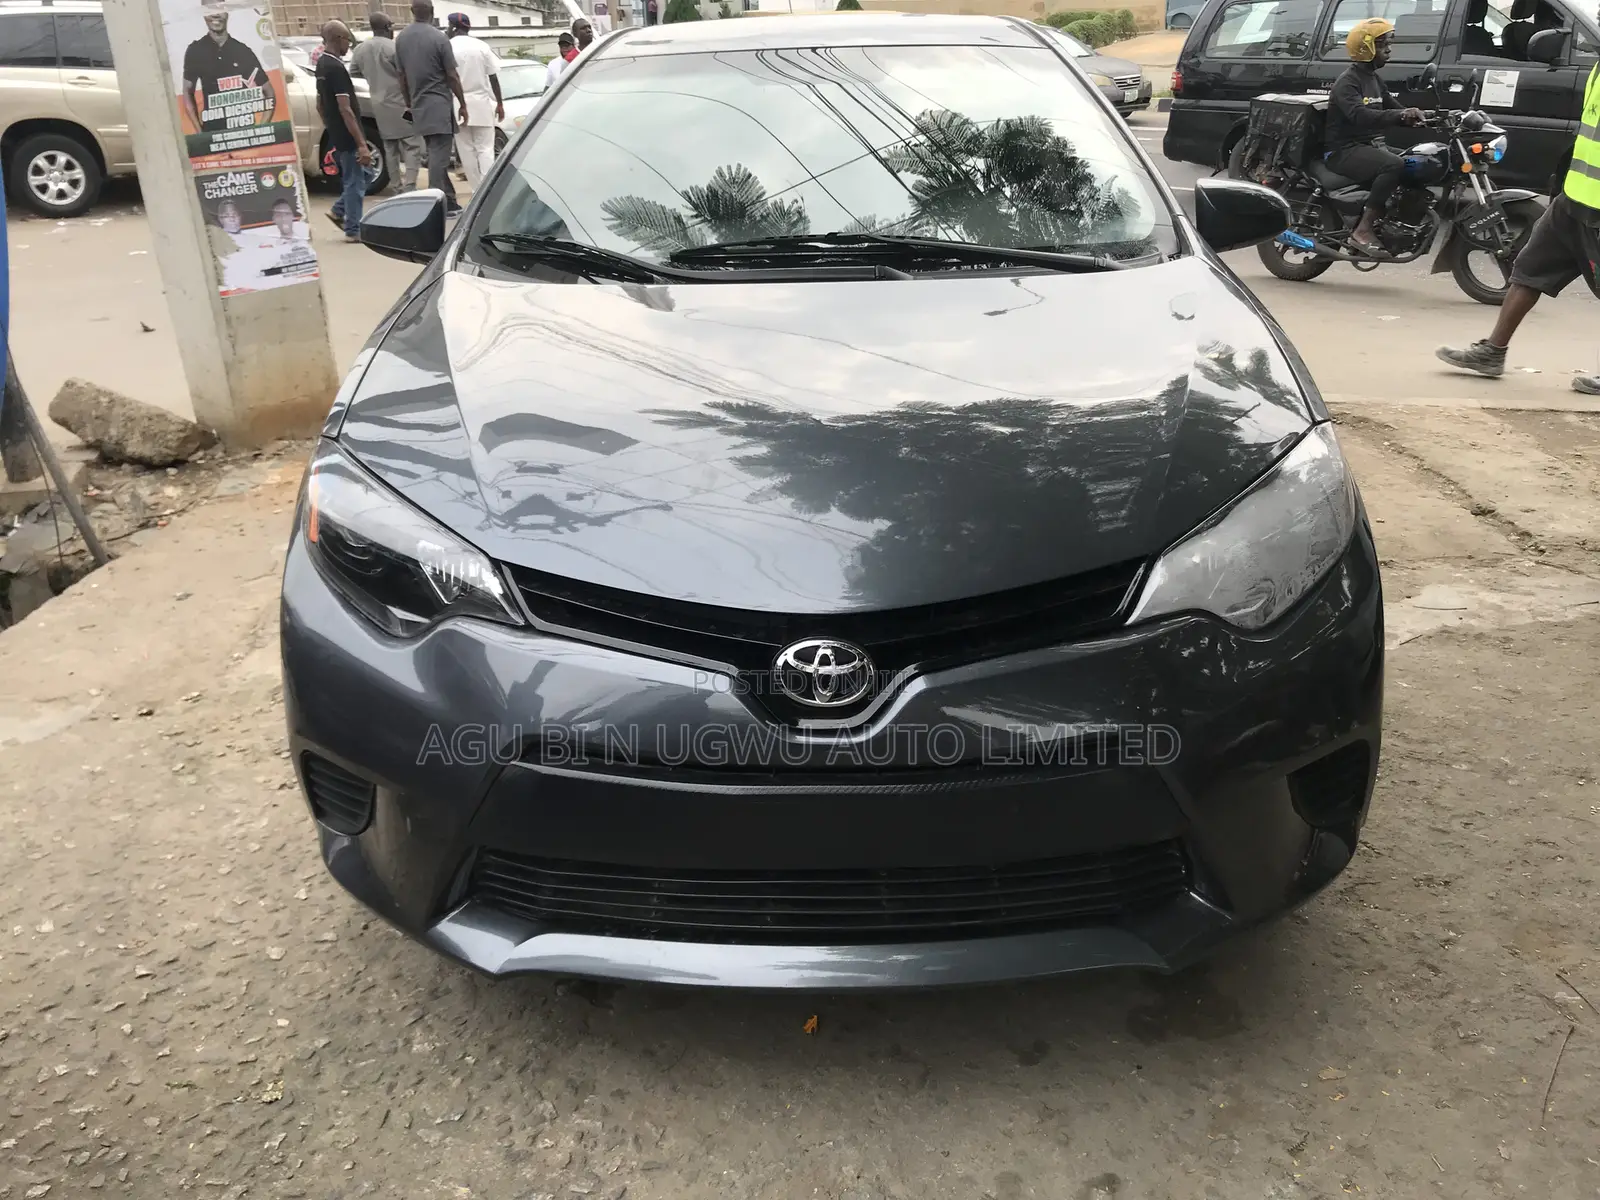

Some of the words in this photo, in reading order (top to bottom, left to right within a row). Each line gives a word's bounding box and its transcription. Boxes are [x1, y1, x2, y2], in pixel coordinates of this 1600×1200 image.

[218, 75, 242, 91] VOTE
[209, 87, 262, 108] HONORABLE
[202, 107, 225, 123] ODIA
[225, 100, 265, 118] DICKSON
[203, 181, 218, 190] THE
[216, 171, 256, 188] GAME
[204, 183, 259, 199] CHANGER
